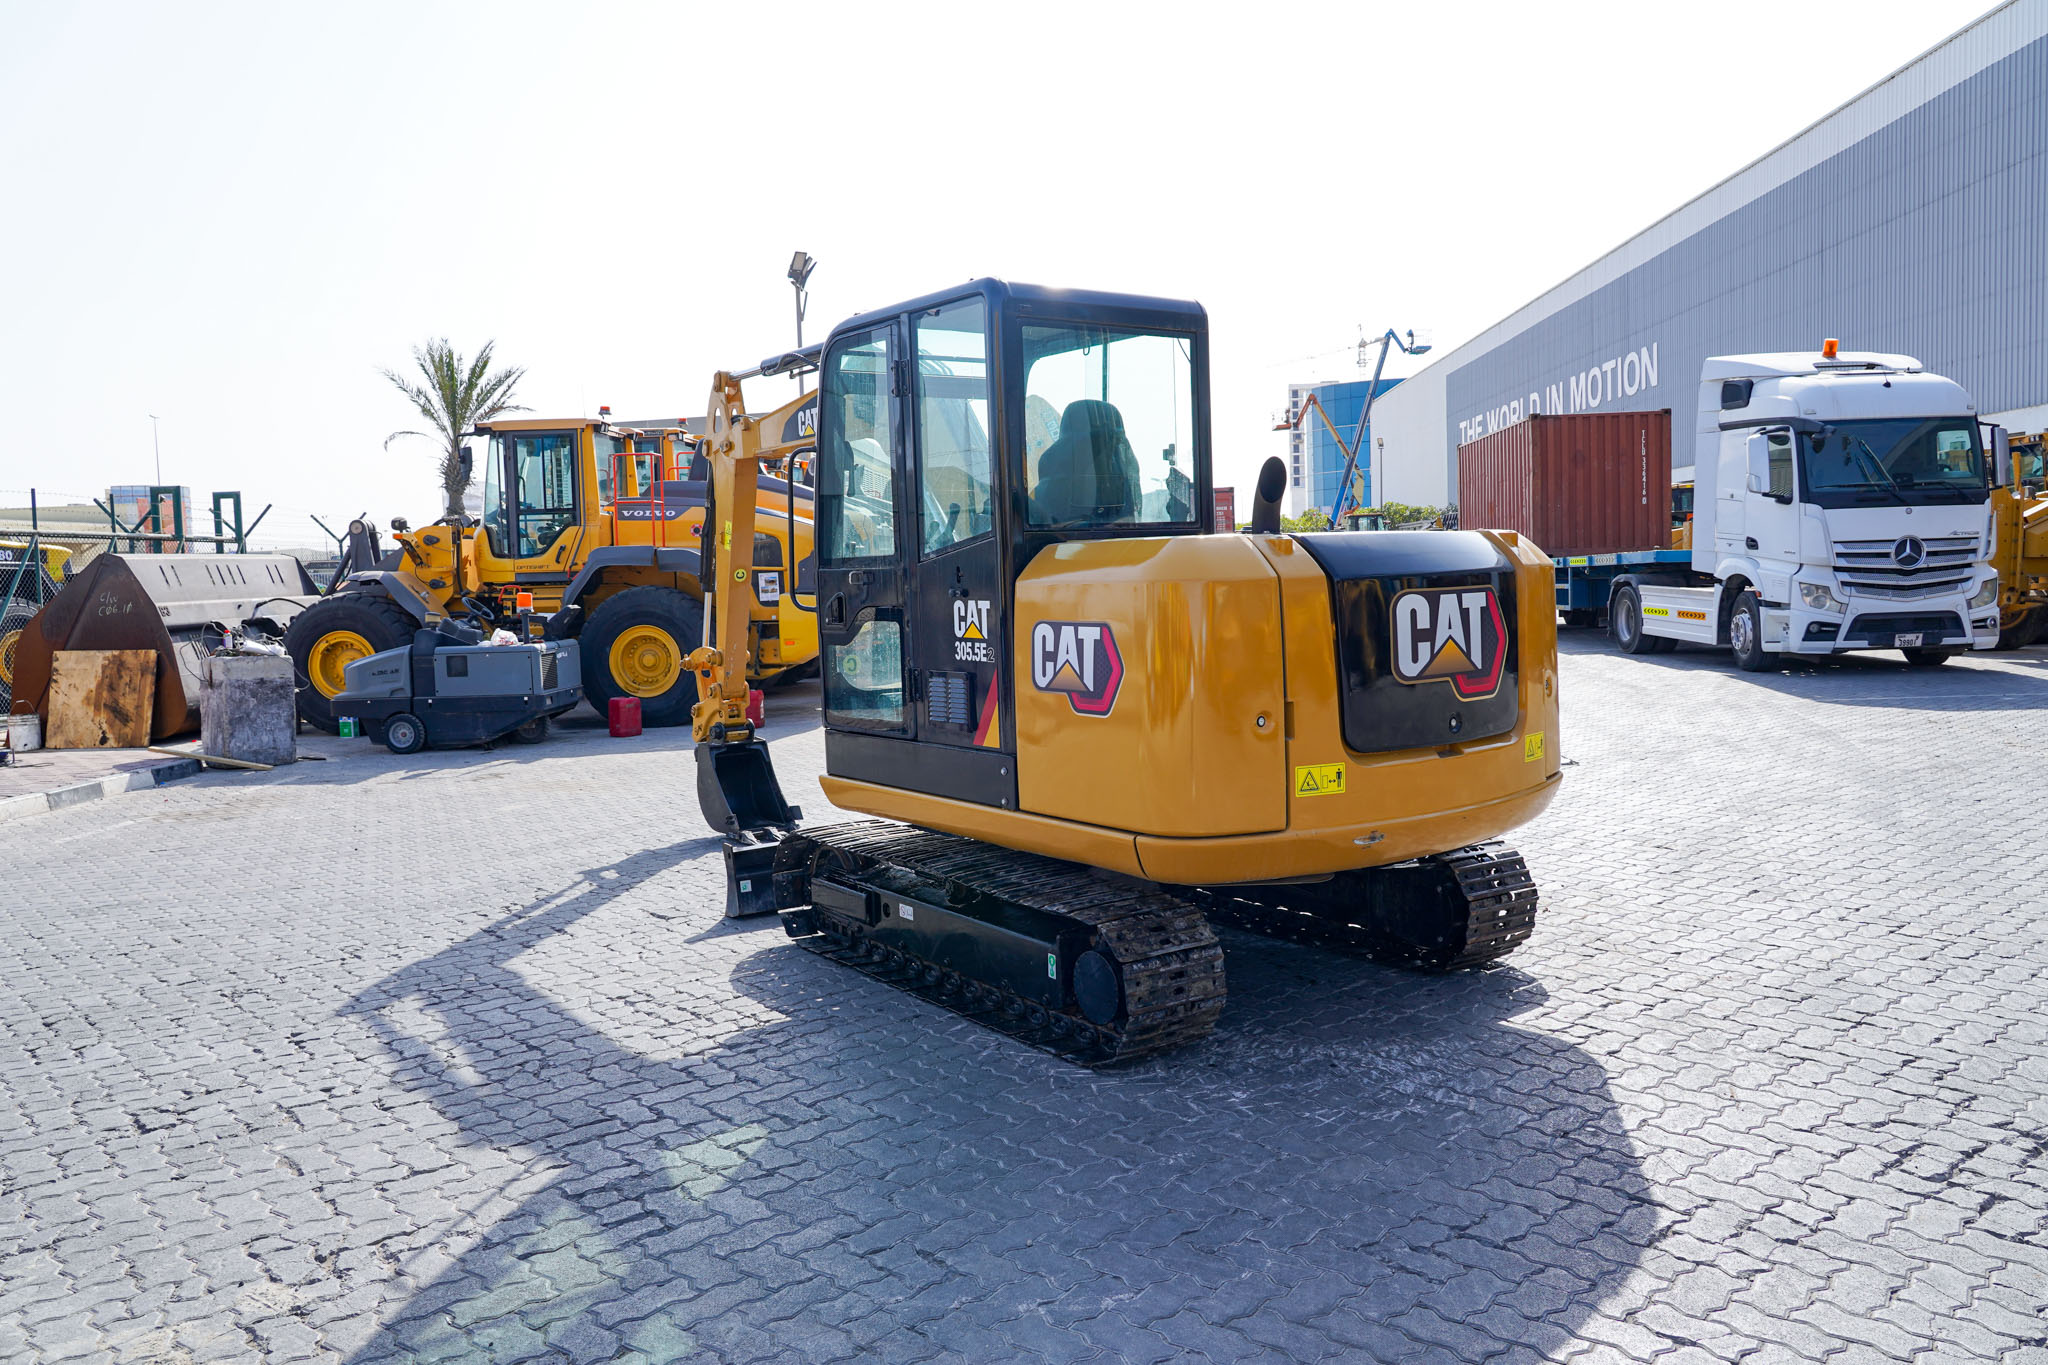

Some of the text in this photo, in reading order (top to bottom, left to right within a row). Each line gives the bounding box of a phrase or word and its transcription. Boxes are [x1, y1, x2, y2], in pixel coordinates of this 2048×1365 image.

[797, 407, 818, 437] CAT
[1459, 414, 1483, 445] THE
[1546, 382, 1563, 416] IN
[1570, 342, 1658, 414] MOTION
[953, 599, 991, 640] CAT
[1396, 591, 1487, 678] CAT
[1033, 623, 1101, 693] CAT
